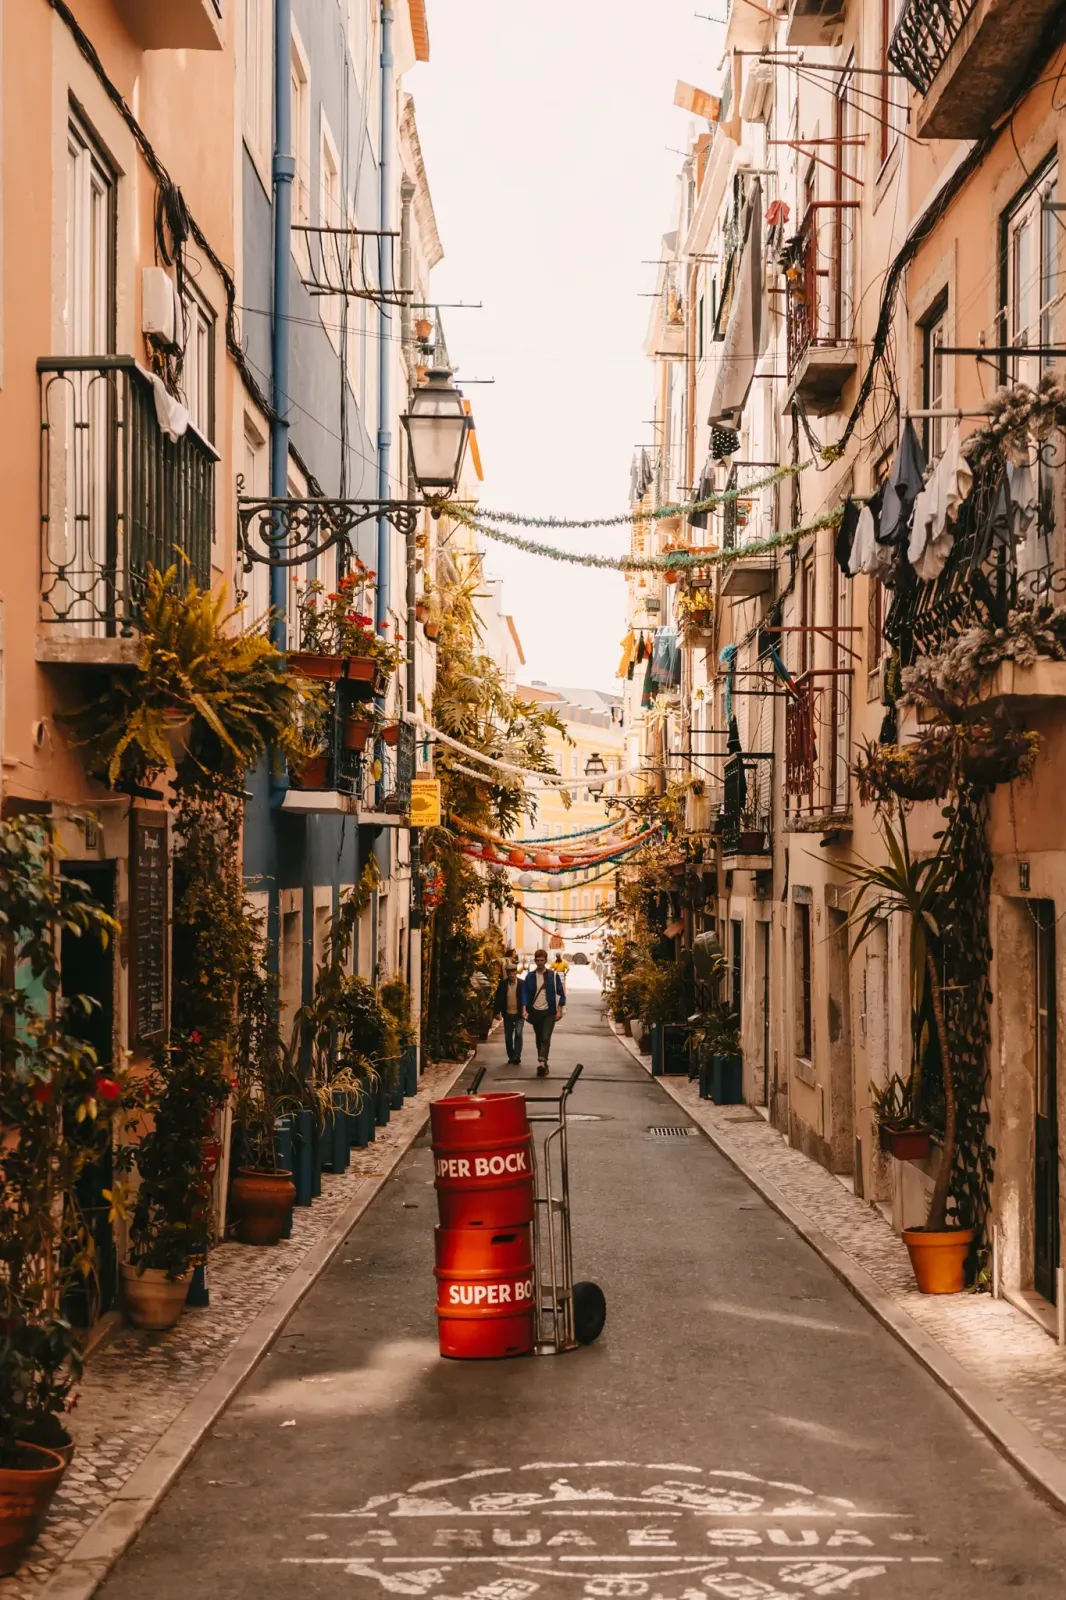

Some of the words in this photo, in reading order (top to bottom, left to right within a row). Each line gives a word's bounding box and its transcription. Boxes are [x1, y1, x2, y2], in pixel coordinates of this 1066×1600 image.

[475, 1151, 526, 1177] BOCK
[449, 1284, 512, 1305] SUPER
[347, 1529, 398, 1547] A
[432, 1528, 598, 1547] RUA
[705, 1528, 875, 1547] SUA
